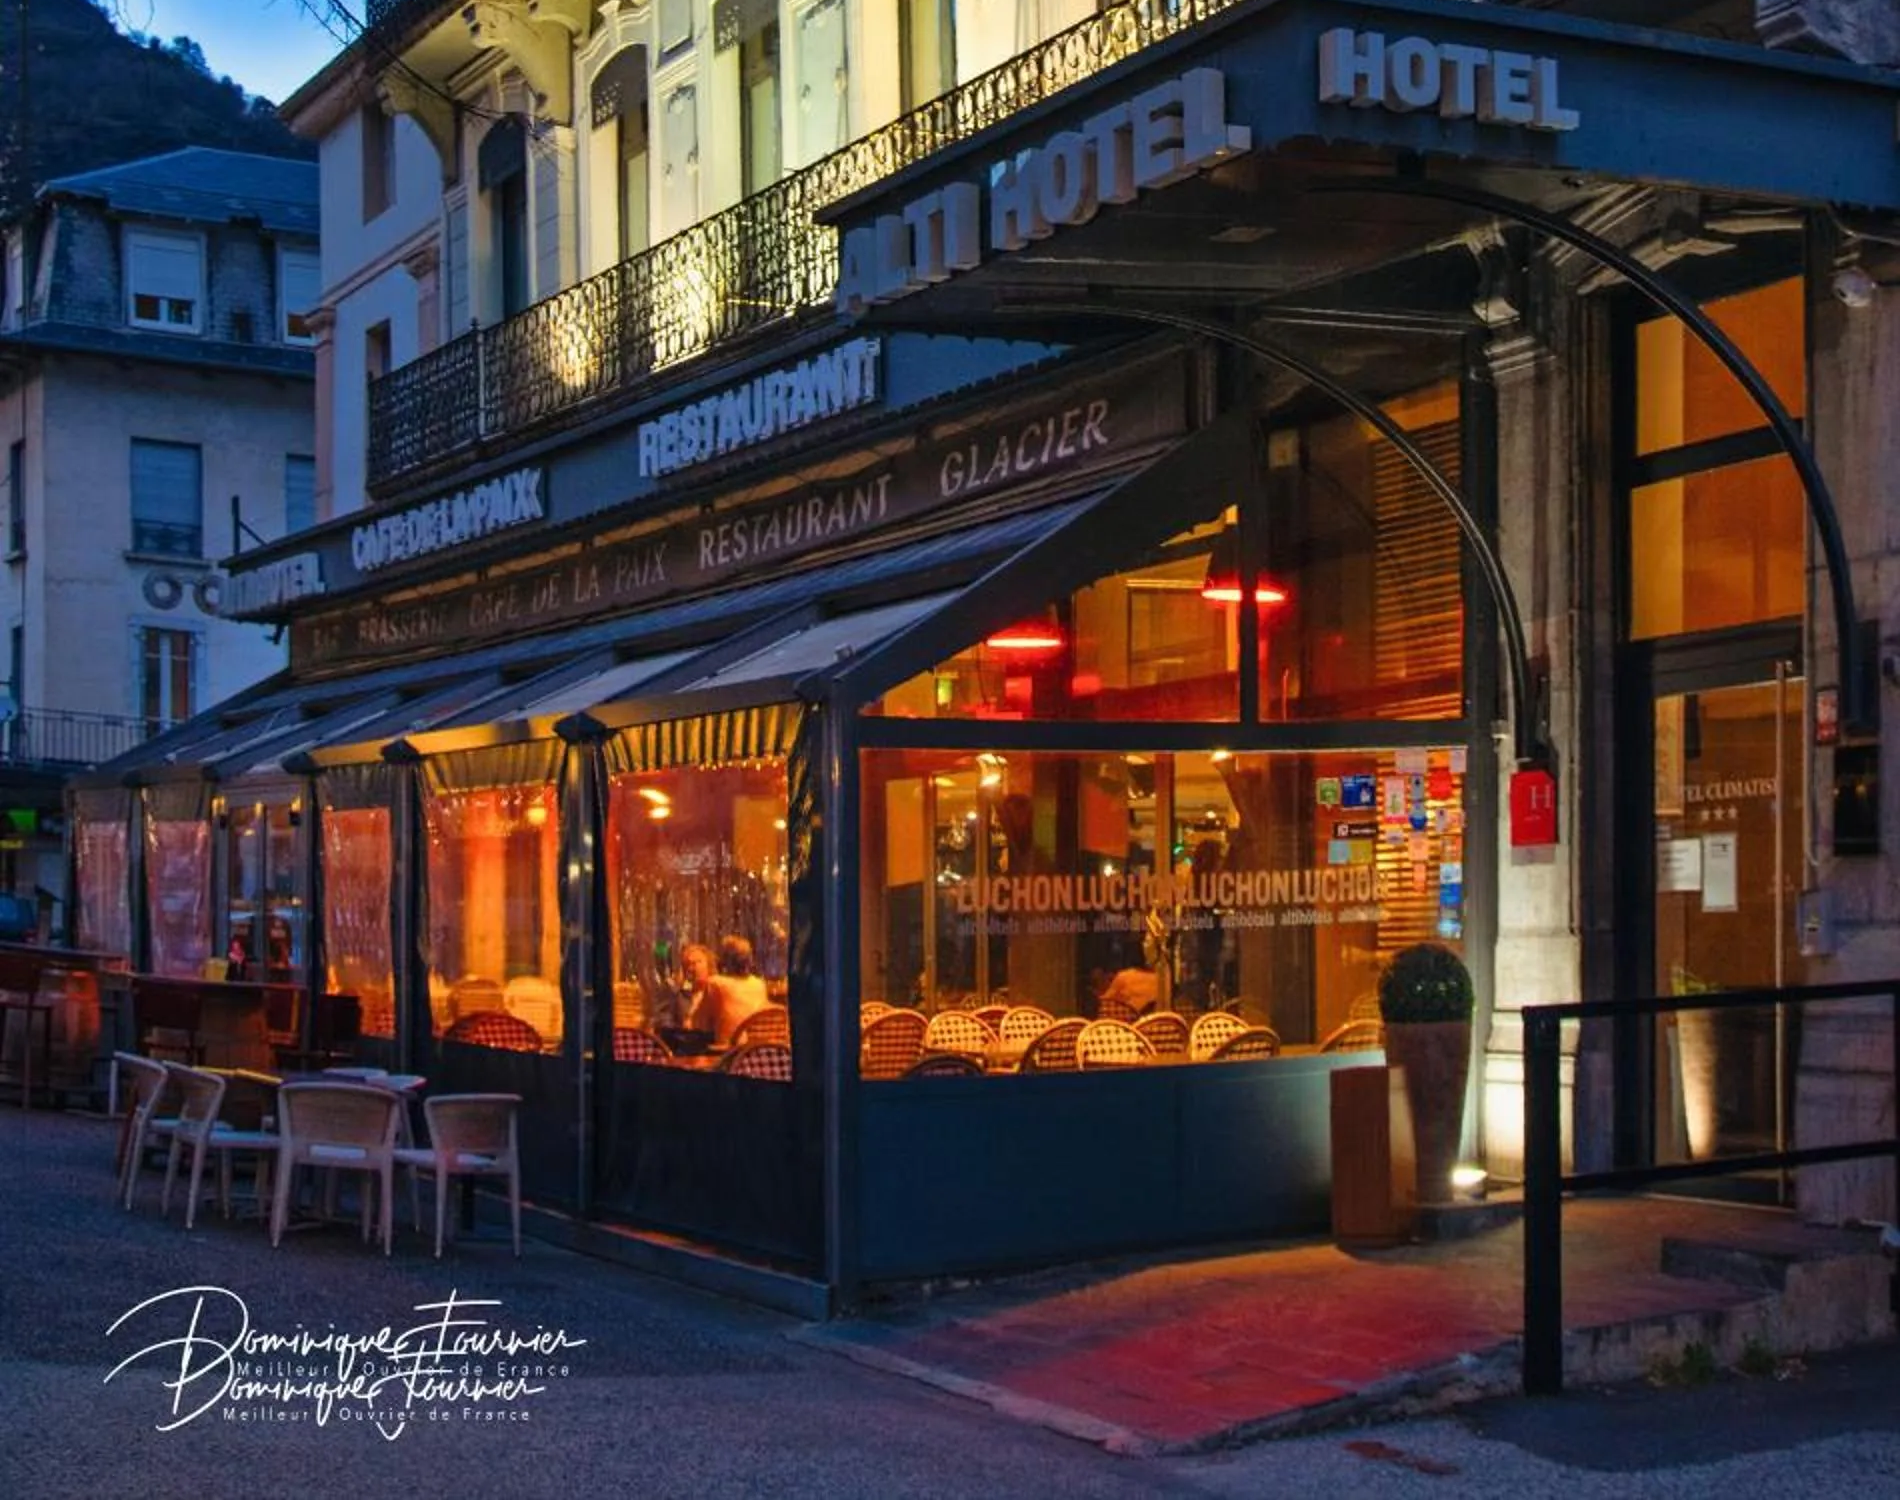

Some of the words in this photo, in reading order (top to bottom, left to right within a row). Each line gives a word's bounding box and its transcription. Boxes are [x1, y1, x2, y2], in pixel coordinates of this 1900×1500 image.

[1318, 26, 1580, 132] HOTEL
[832, 180, 982, 324] ALTI
[990, 67, 1252, 251] HOTEL
[638, 336, 880, 478] RESTAURANT
[573, 564, 600, 603] LA
[613, 542, 667, 594] PAIX
[699, 473, 893, 570] RESTAURANT
[939, 398, 1109, 498] GLACIER
